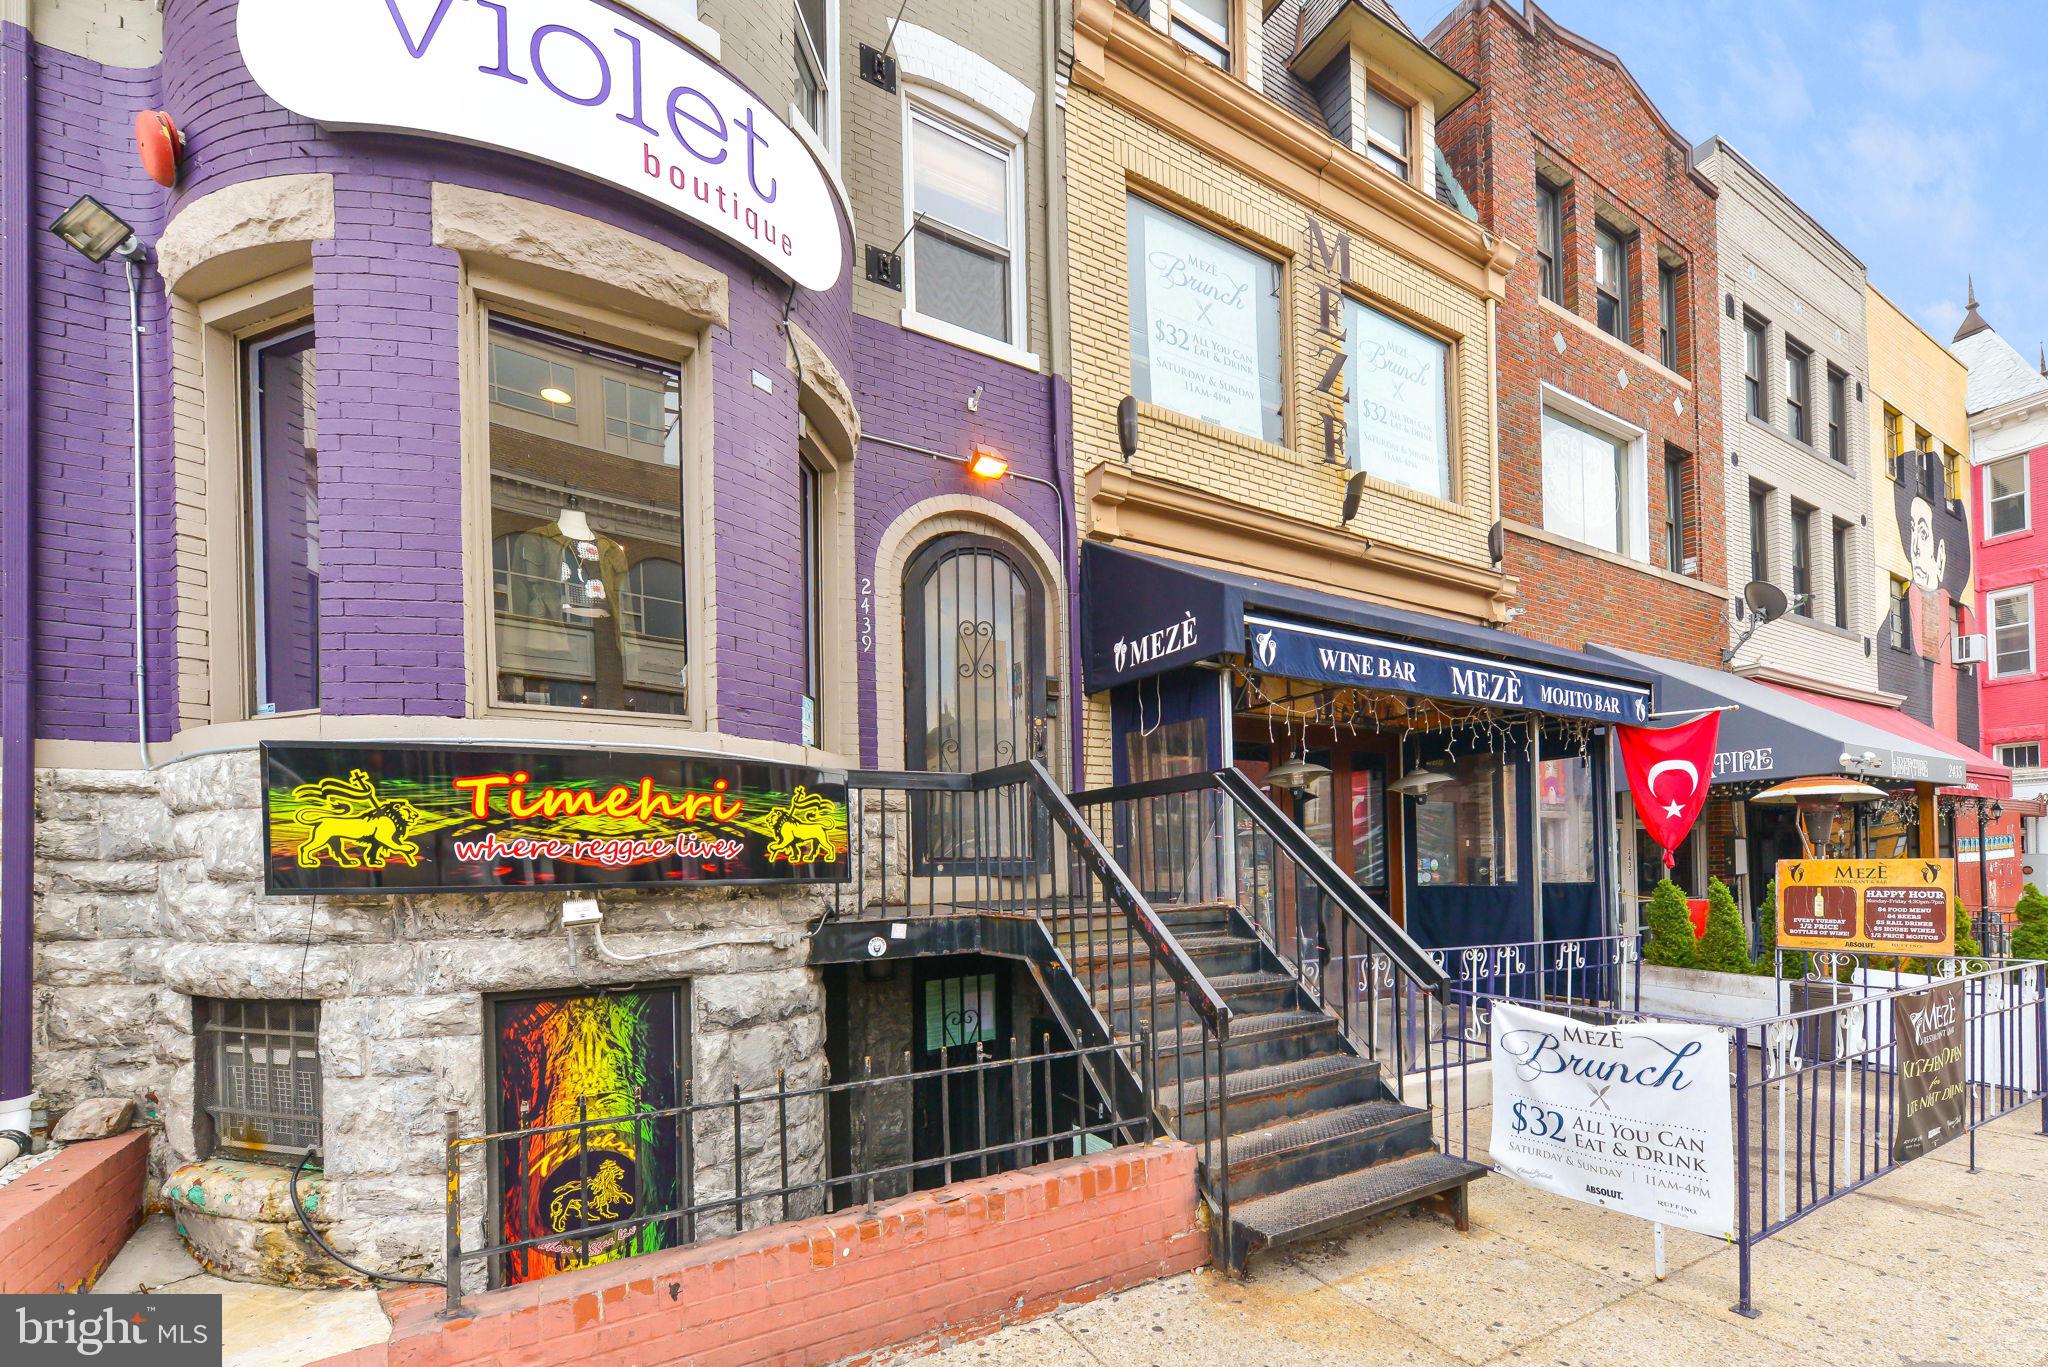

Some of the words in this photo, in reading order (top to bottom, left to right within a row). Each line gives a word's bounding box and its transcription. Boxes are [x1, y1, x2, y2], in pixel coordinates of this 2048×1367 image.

[643, 142, 793, 257] boutique
[1149, 252, 1249, 310] Brunch
[1155, 319, 1189, 351] $32
[1192, 333, 1209, 348] ALL
[1211, 340, 1231, 356] YOU
[1232, 348, 1253, 365] CAN
[1156, 355, 1206, 382] SATURDAY
[1208, 376, 1216, 387] &
[1219, 379, 1255, 400] SUNDAY
[1194, 345, 1210, 359] EAT
[1213, 352, 1221, 363] &
[1223, 356, 1253, 375] DRINK
[1360, 339, 1431, 386] Brunch
[1363, 398, 1387, 424] $32
[860, 577, 872, 653] 2439
[1129, 611, 1197, 667] MEZÈ
[1318, 647, 1374, 676] WINE
[1378, 657, 1416, 682] BAR
[1450, 666, 1523, 705] MEZÈ
[1540, 684, 1593, 710] MOJITO
[1595, 694, 1621, 714] BAR
[452, 770, 743, 824] Timehri
[454, 833, 571, 861] where
[572, 837, 674, 865] reggae
[676, 833, 743, 860] lives
[1866, 890, 1906, 898] HAPPY
[1909, 891, 1945, 899] HOUR
[1563, 1025, 1624, 1049] MEZÈ
[1500, 1029, 1702, 1091] Brunch
[1511, 1100, 1566, 1143] $32
[1572, 1116, 1605, 1136] ALL
[1610, 1122, 1649, 1143] YOU
[1657, 1130, 1705, 1153] CAN
[1508, 1141, 1563, 1163] SATURDAY
[1566, 1156, 1575, 1166] &
[1577, 1159, 1622, 1179] SUNDAY
[1645, 1174, 1711, 1199] 11AM-4PM
[1575, 1132, 1606, 1153] EAT
[1612, 1142, 1628, 1158] &
[1636, 1145, 1708, 1173] DRINK
